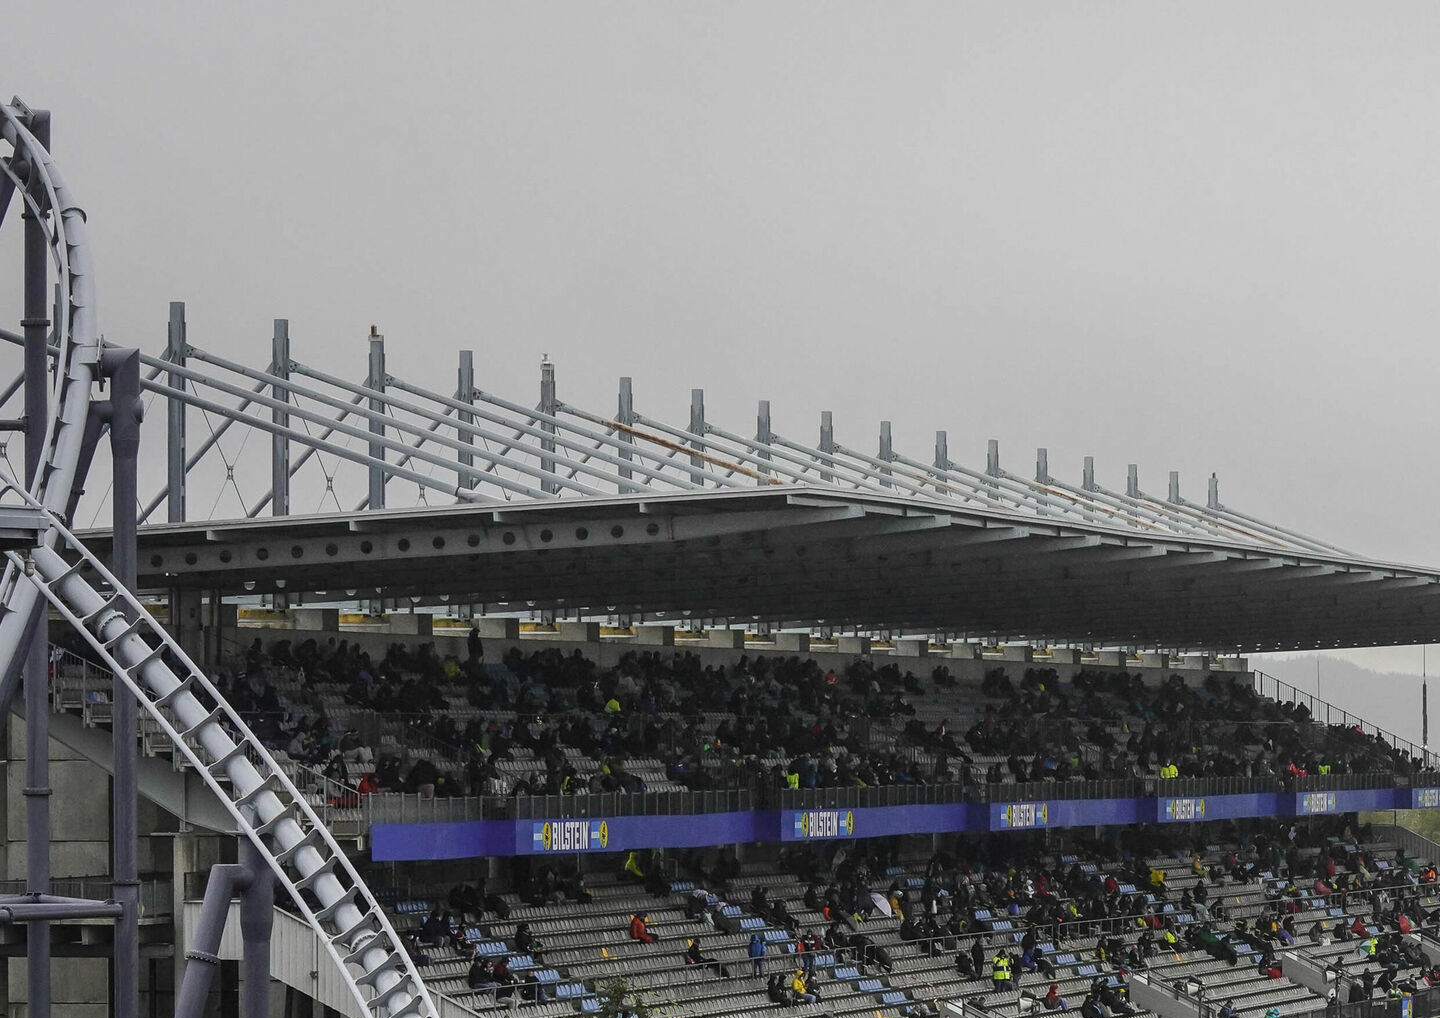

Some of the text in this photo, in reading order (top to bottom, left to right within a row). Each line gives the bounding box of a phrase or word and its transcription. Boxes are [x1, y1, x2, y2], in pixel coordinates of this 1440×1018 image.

[809, 812, 838, 837] BILSTEIN
[1012, 804, 1036, 827] BILSTEIN
[552, 820, 590, 850] BILSTEIN
